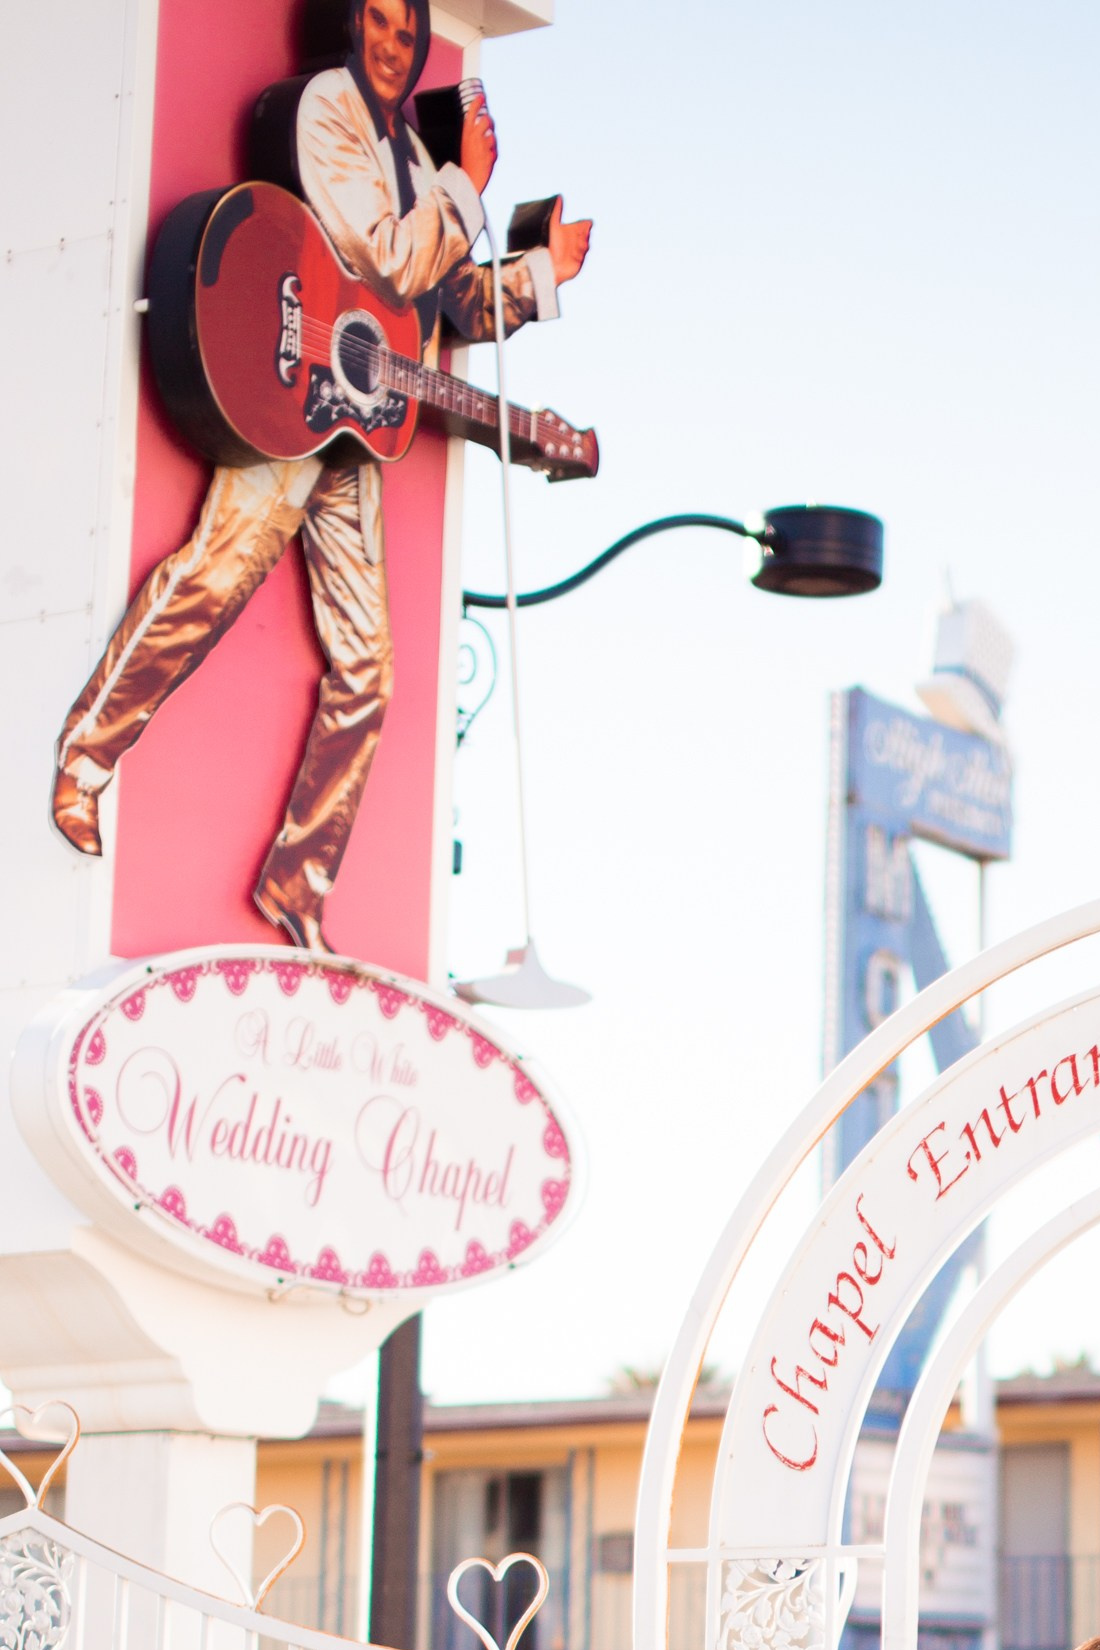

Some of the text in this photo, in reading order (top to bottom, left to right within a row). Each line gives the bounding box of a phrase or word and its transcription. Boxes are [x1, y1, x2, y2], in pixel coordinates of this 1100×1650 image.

[115, 1045, 516, 1232] Wedding Chapel
[234, 1007, 419, 1087] A Little White
[763, 1194, 896, 1472] Chapel
